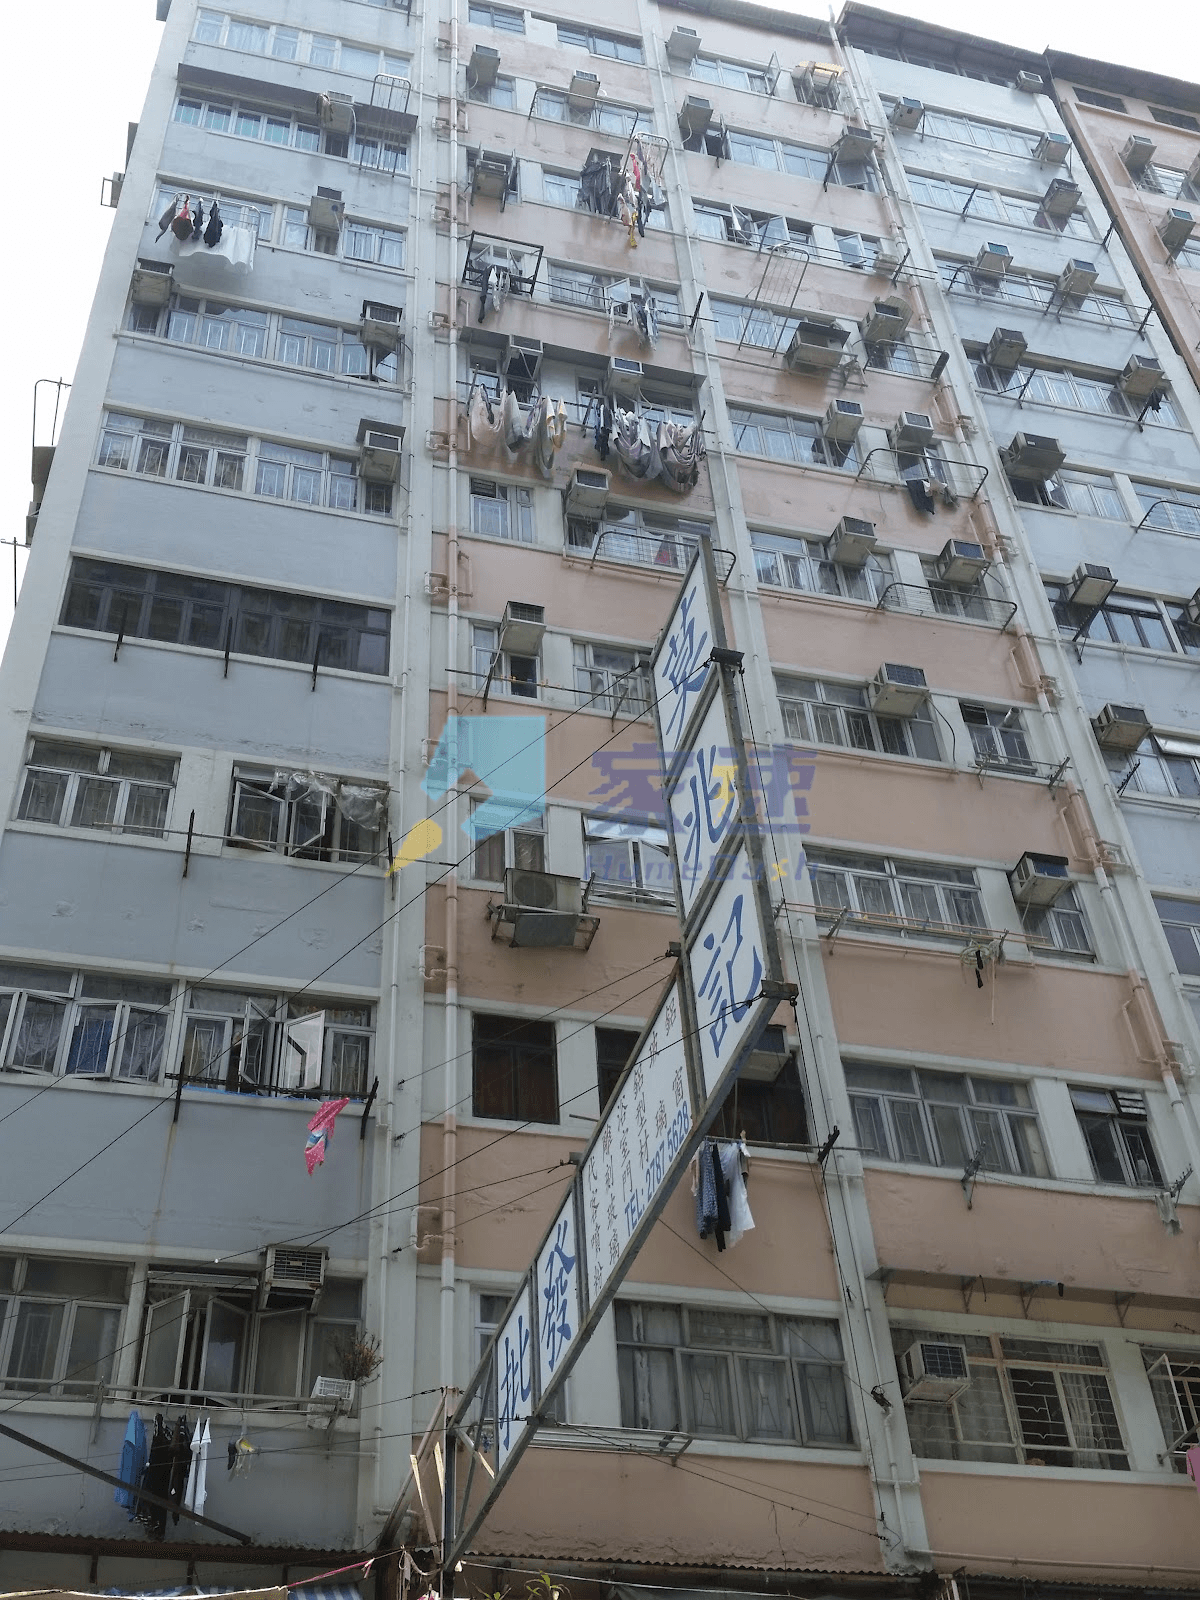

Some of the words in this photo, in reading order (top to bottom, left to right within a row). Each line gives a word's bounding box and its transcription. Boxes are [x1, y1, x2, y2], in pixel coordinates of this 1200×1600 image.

[624, 1187, 645, 1237] TEL:
[645, 1141, 665, 1202] 2787
[667, 1100, 690, 1163] 5628
